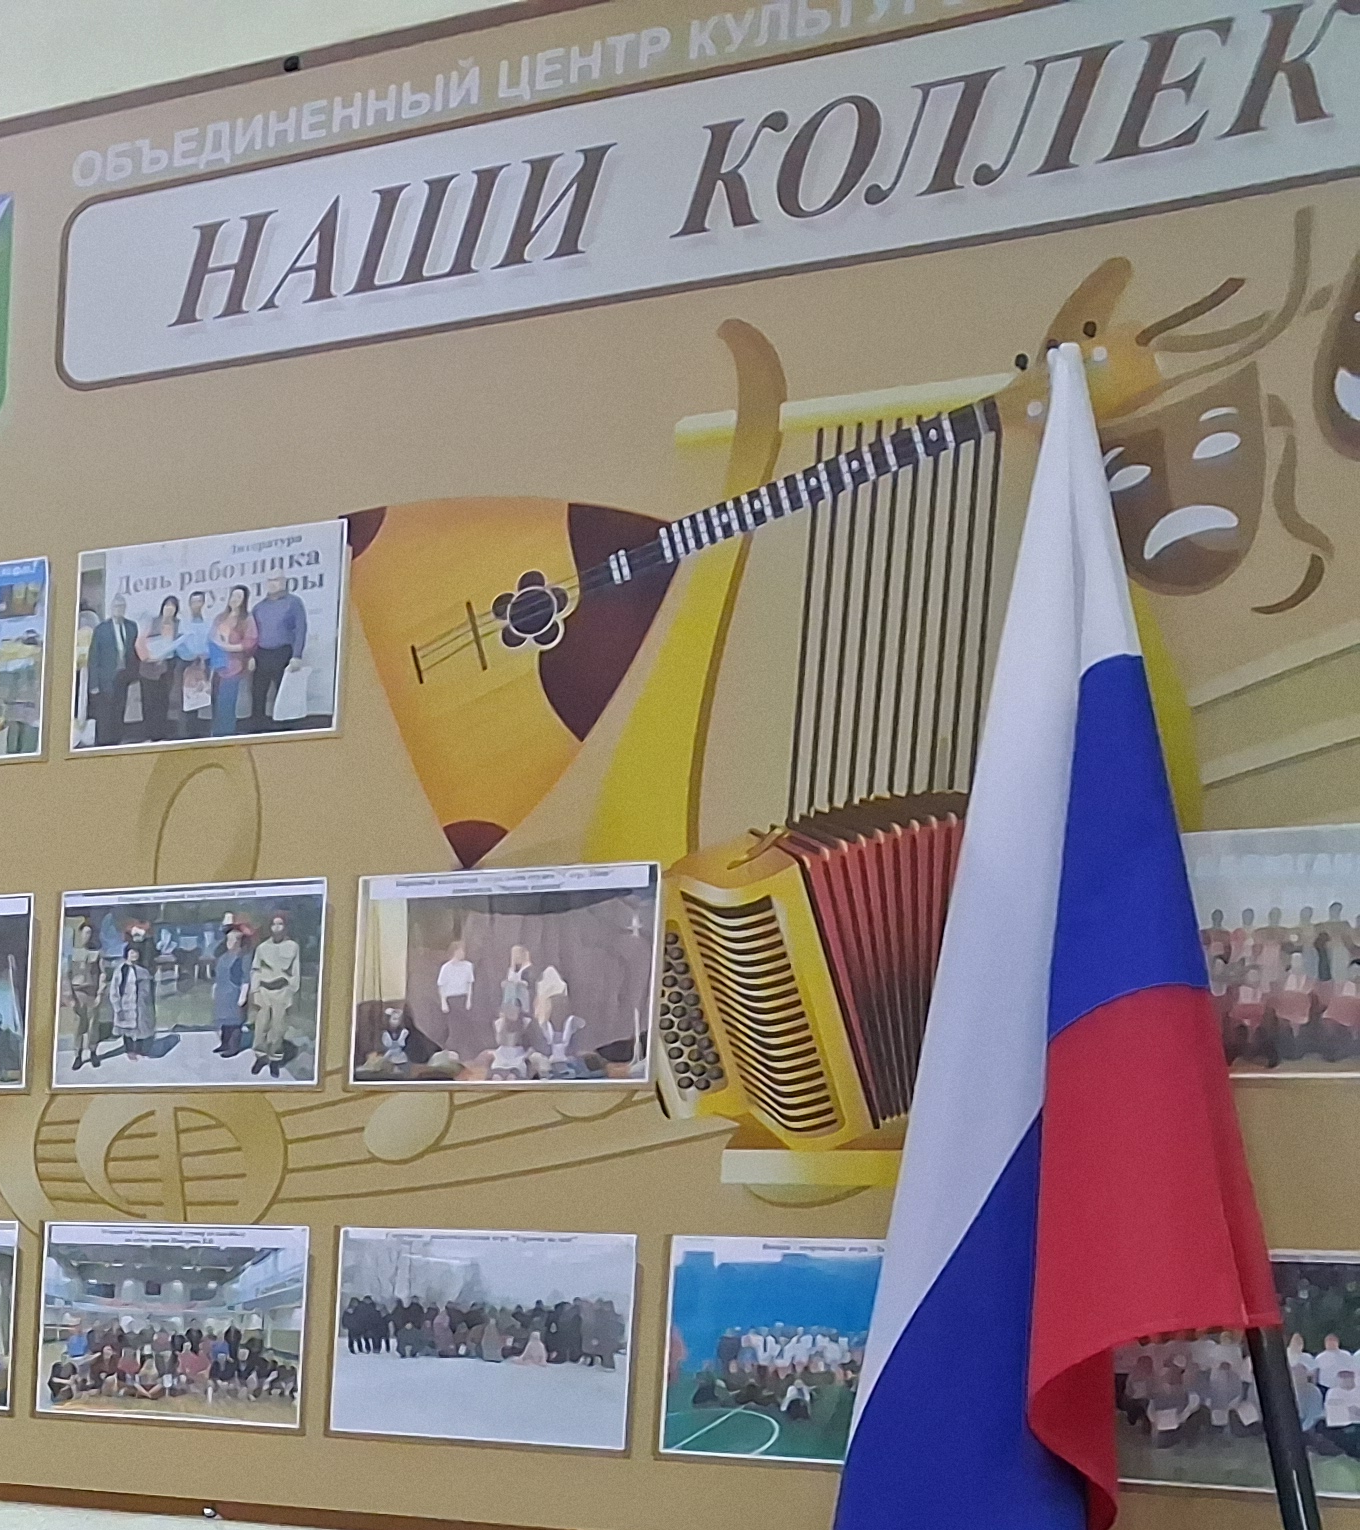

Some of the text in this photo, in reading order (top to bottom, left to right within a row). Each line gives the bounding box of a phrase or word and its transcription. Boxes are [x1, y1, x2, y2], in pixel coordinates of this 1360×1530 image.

[72, 58, 482, 188] ОБЪЕДИНЕННЫЙ
[496, 26, 670, 102] ЦЕНТР
[168, 0, 1360, 328] НАШИ КОЛЛЕК
[115, 550, 321, 597] День работника
